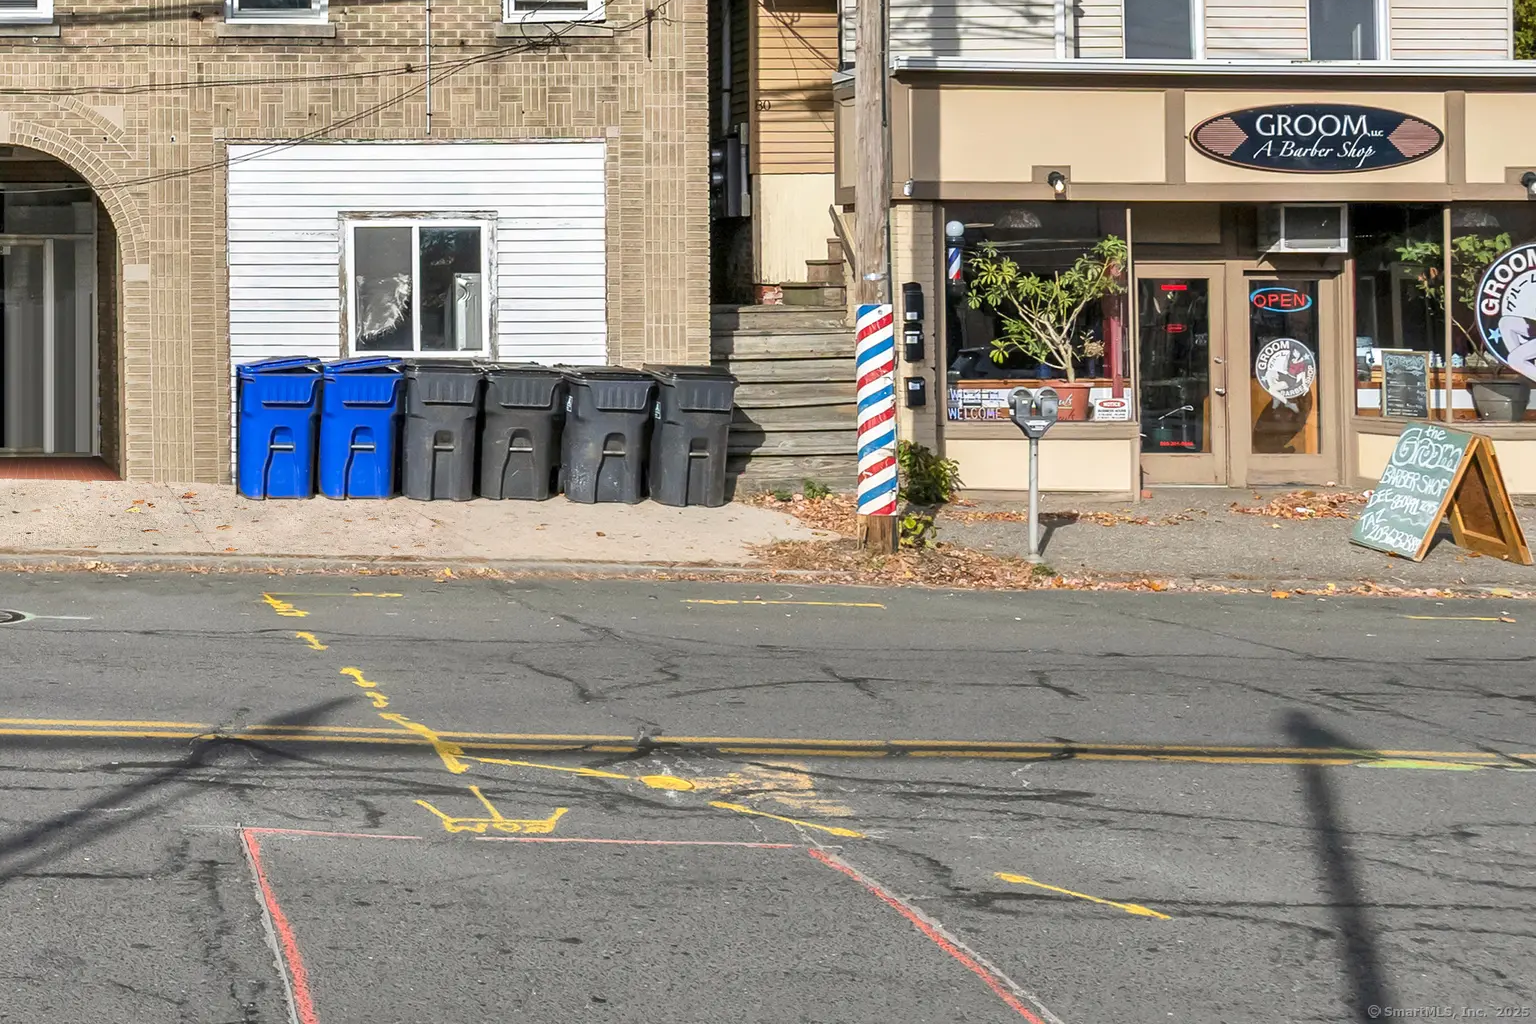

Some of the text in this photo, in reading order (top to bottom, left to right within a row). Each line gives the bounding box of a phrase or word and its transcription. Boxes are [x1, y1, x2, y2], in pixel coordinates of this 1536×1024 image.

[1255, 114, 1370, 137] GROOM
[1253, 132, 1375, 168] A Barber Shop
[1253, 293, 1307, 308] OPEN
[1258, 340, 1290, 370] GROOM
[948, 406, 1002, 420] WELCOME
[1423, 425, 1447, 440] the
[1391, 427, 1463, 473] Groom
[1379, 464, 1450, 497] BARBER SHOP
[1366, 487, 1394, 509] DEE
[1359, 507, 1388, 532] TAZ
